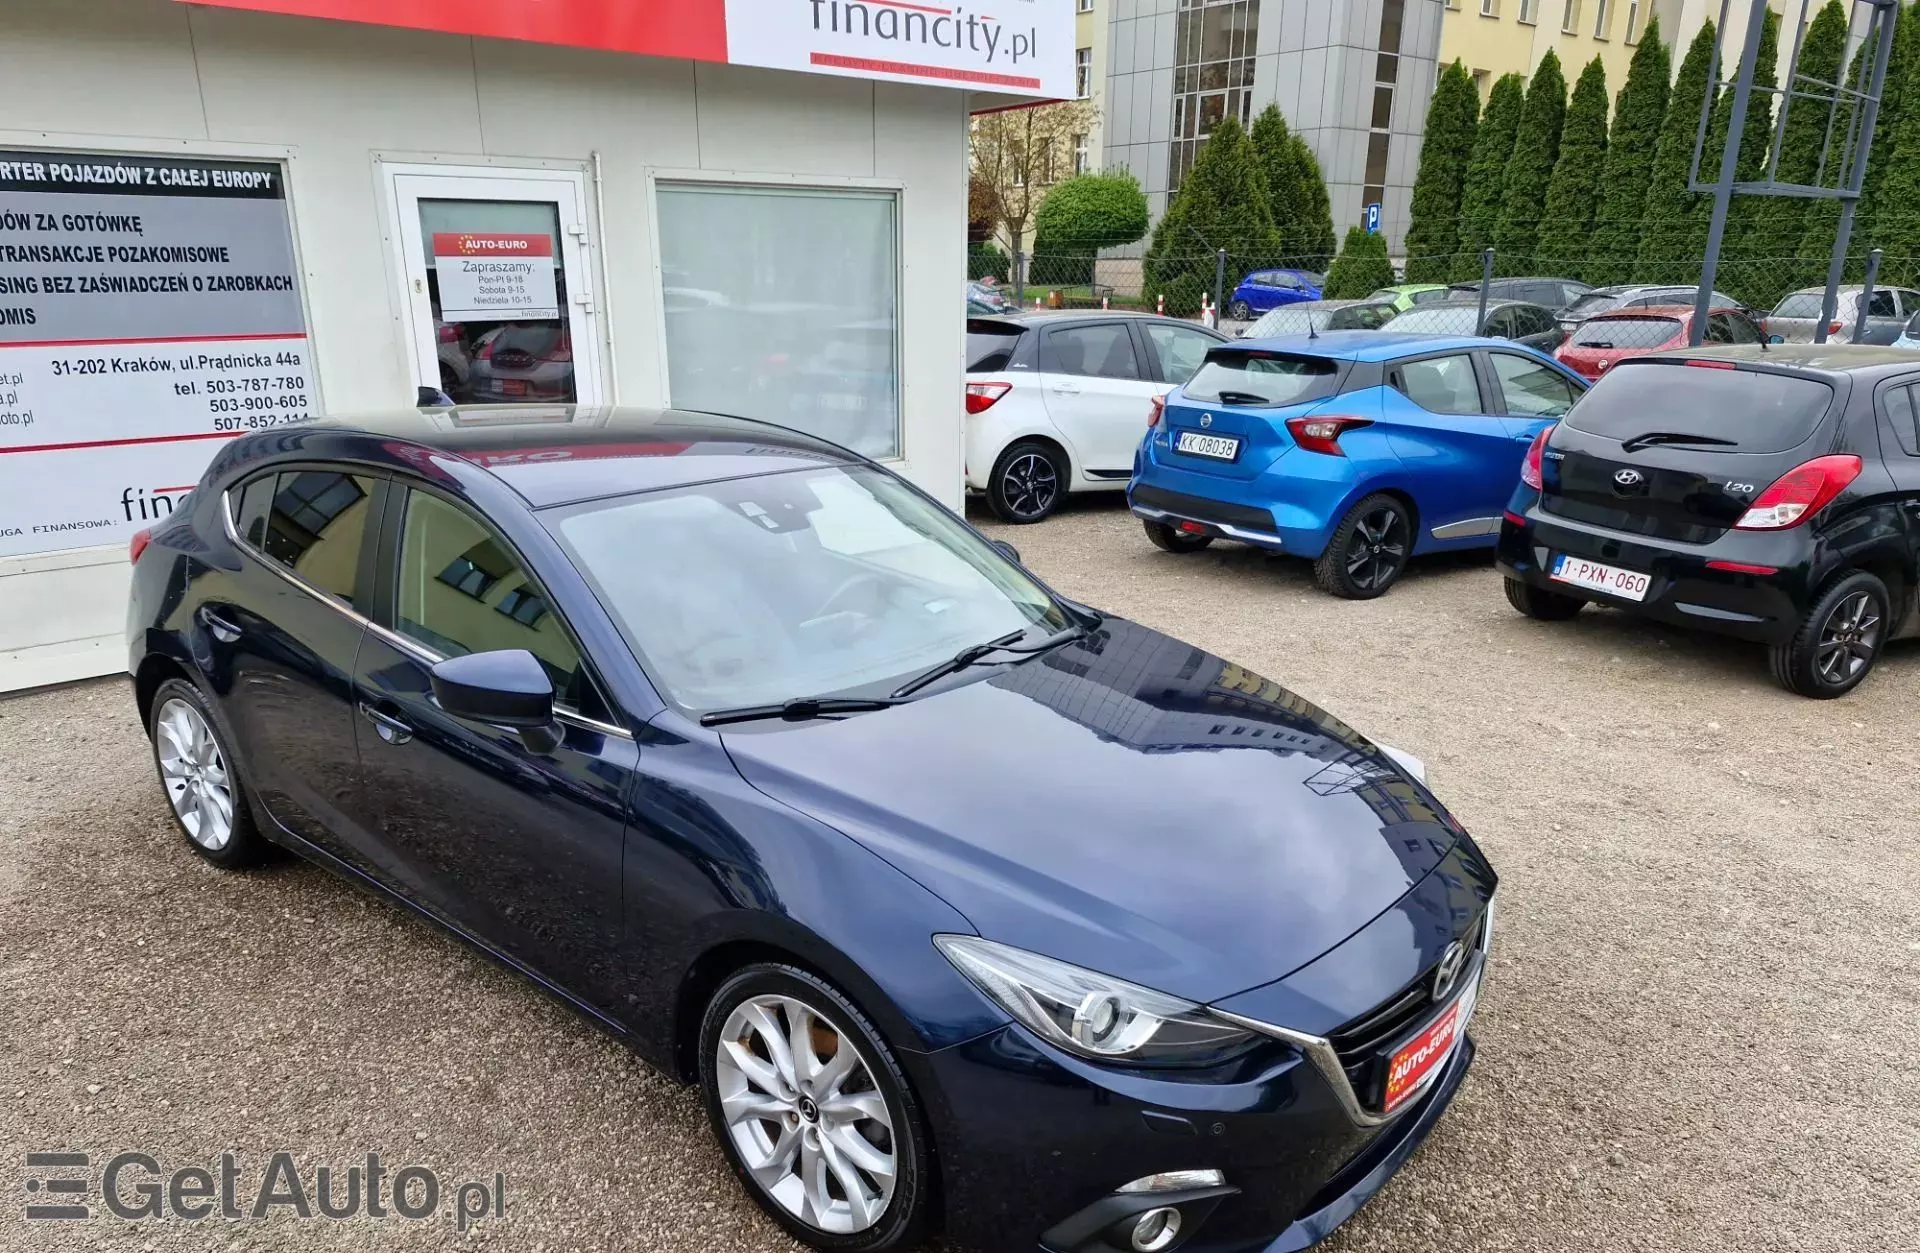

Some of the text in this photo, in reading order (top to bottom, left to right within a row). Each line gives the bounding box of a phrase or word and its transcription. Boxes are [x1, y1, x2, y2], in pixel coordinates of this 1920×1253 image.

[810, 0, 1036, 64] financity.pl
[49, 163, 141, 185] POJAZDÓW
[145, 167, 157, 185] Z
[160, 168, 208, 187] CAŁEJ
[212, 170, 271, 189] EUROPY
[34, 213, 59, 231] ZA
[62, 211, 143, 236] GOTÓWKĘ
[1369, 206, 1378, 228] P
[109, 246, 229, 263] POZAKOMISOWE
[465, 240, 528, 249] AUTO-EURO
[462, 261, 535, 274] Zapraszamy:
[42, 276, 75, 294] BEZ
[79, 272, 188, 294] ZAŚWIADCZEŃ
[192, 276, 203, 292] O
[207, 275, 293, 292] ZAROBKACH
[479, 285, 525, 294] Sobota 9-15
[473, 296, 532, 305] Niedziela 10-15
[51, 352, 301, 376] 31-202 Kraków, ul.Prądnicka 44a
[174, 376, 304, 395] tel. 503-787-780
[210, 394, 308, 413] 503-900-605
[1181, 434, 1196, 450] KK
[1199, 438, 1234, 456] 08038
[33, 519, 118, 534] FINANSOWA:
[1393, 1018, 1455, 1082] AUTO-EURO
